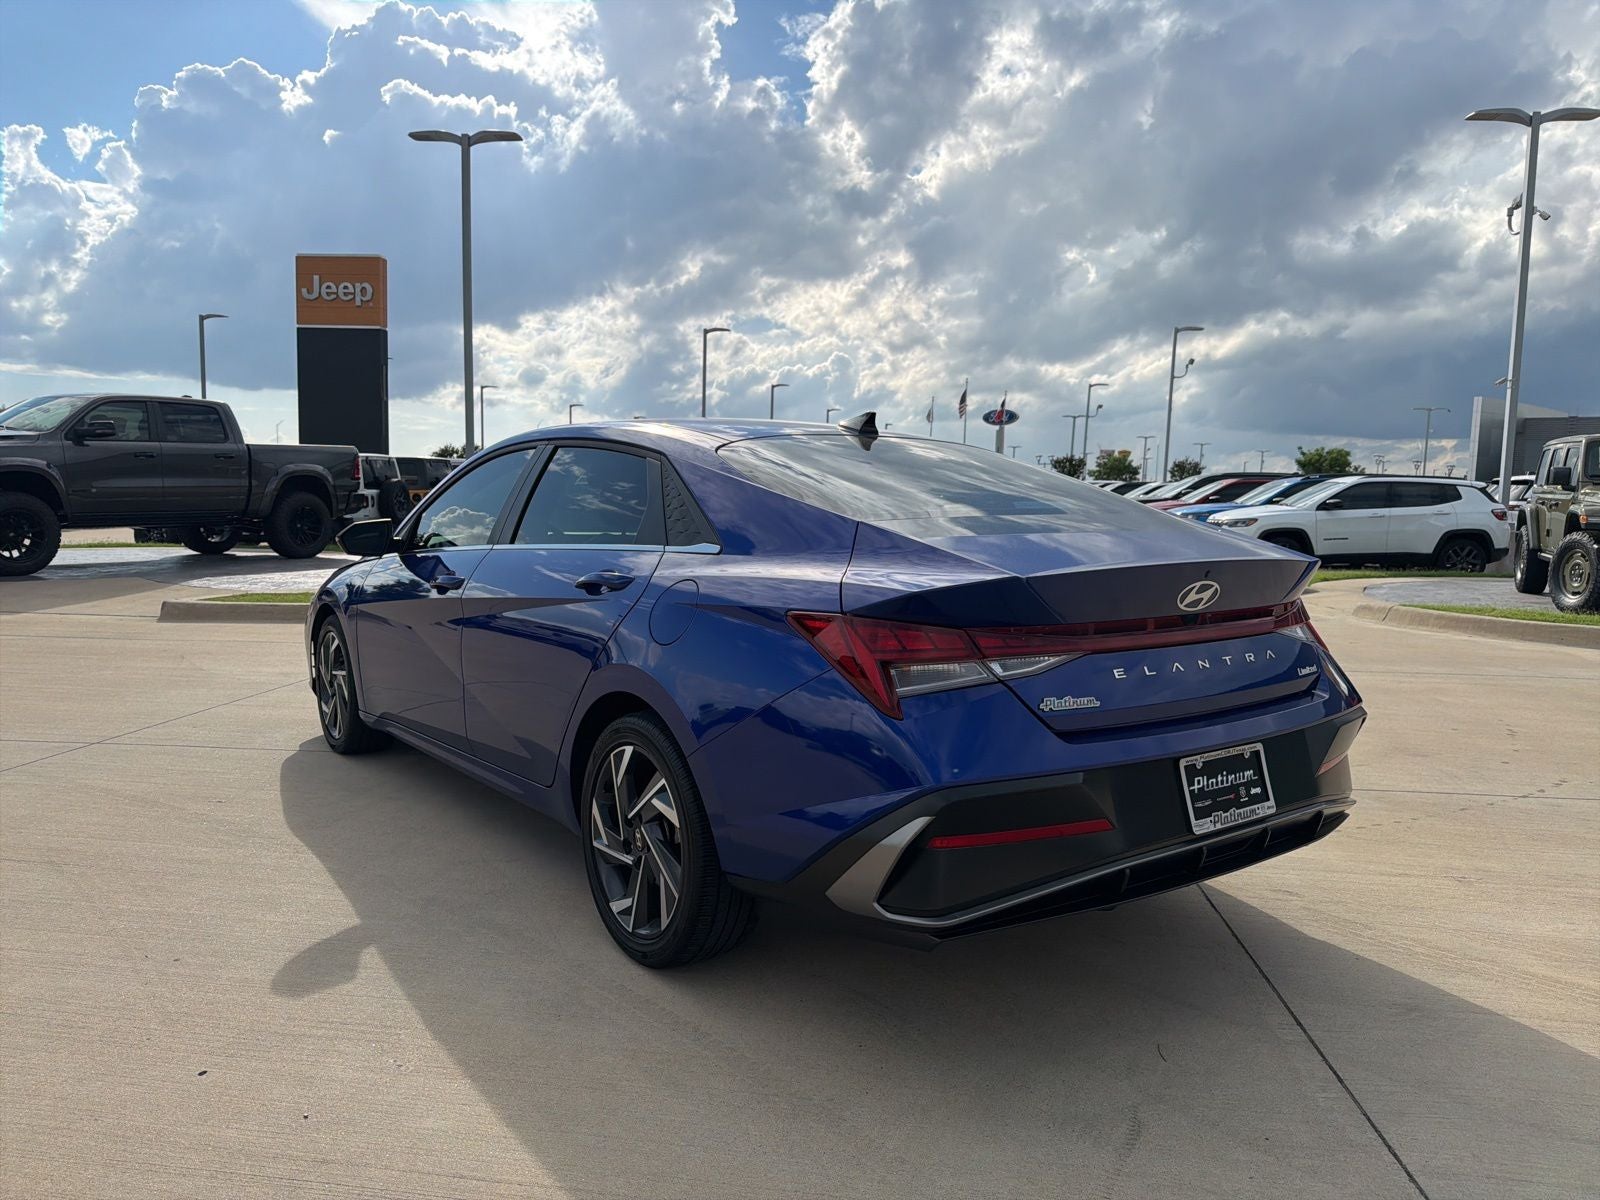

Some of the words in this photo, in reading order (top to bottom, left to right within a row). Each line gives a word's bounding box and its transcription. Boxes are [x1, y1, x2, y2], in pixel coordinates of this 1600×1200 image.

[301, 274, 373, 306] Jeep
[1113, 650, 1276, 679] ELANTRA
[1297, 664, 1318, 676] Limited
[1039, 696, 1101, 711] Platinum
[1189, 769, 1258, 794] Platinum
[1212, 807, 1260, 829] Platinum
